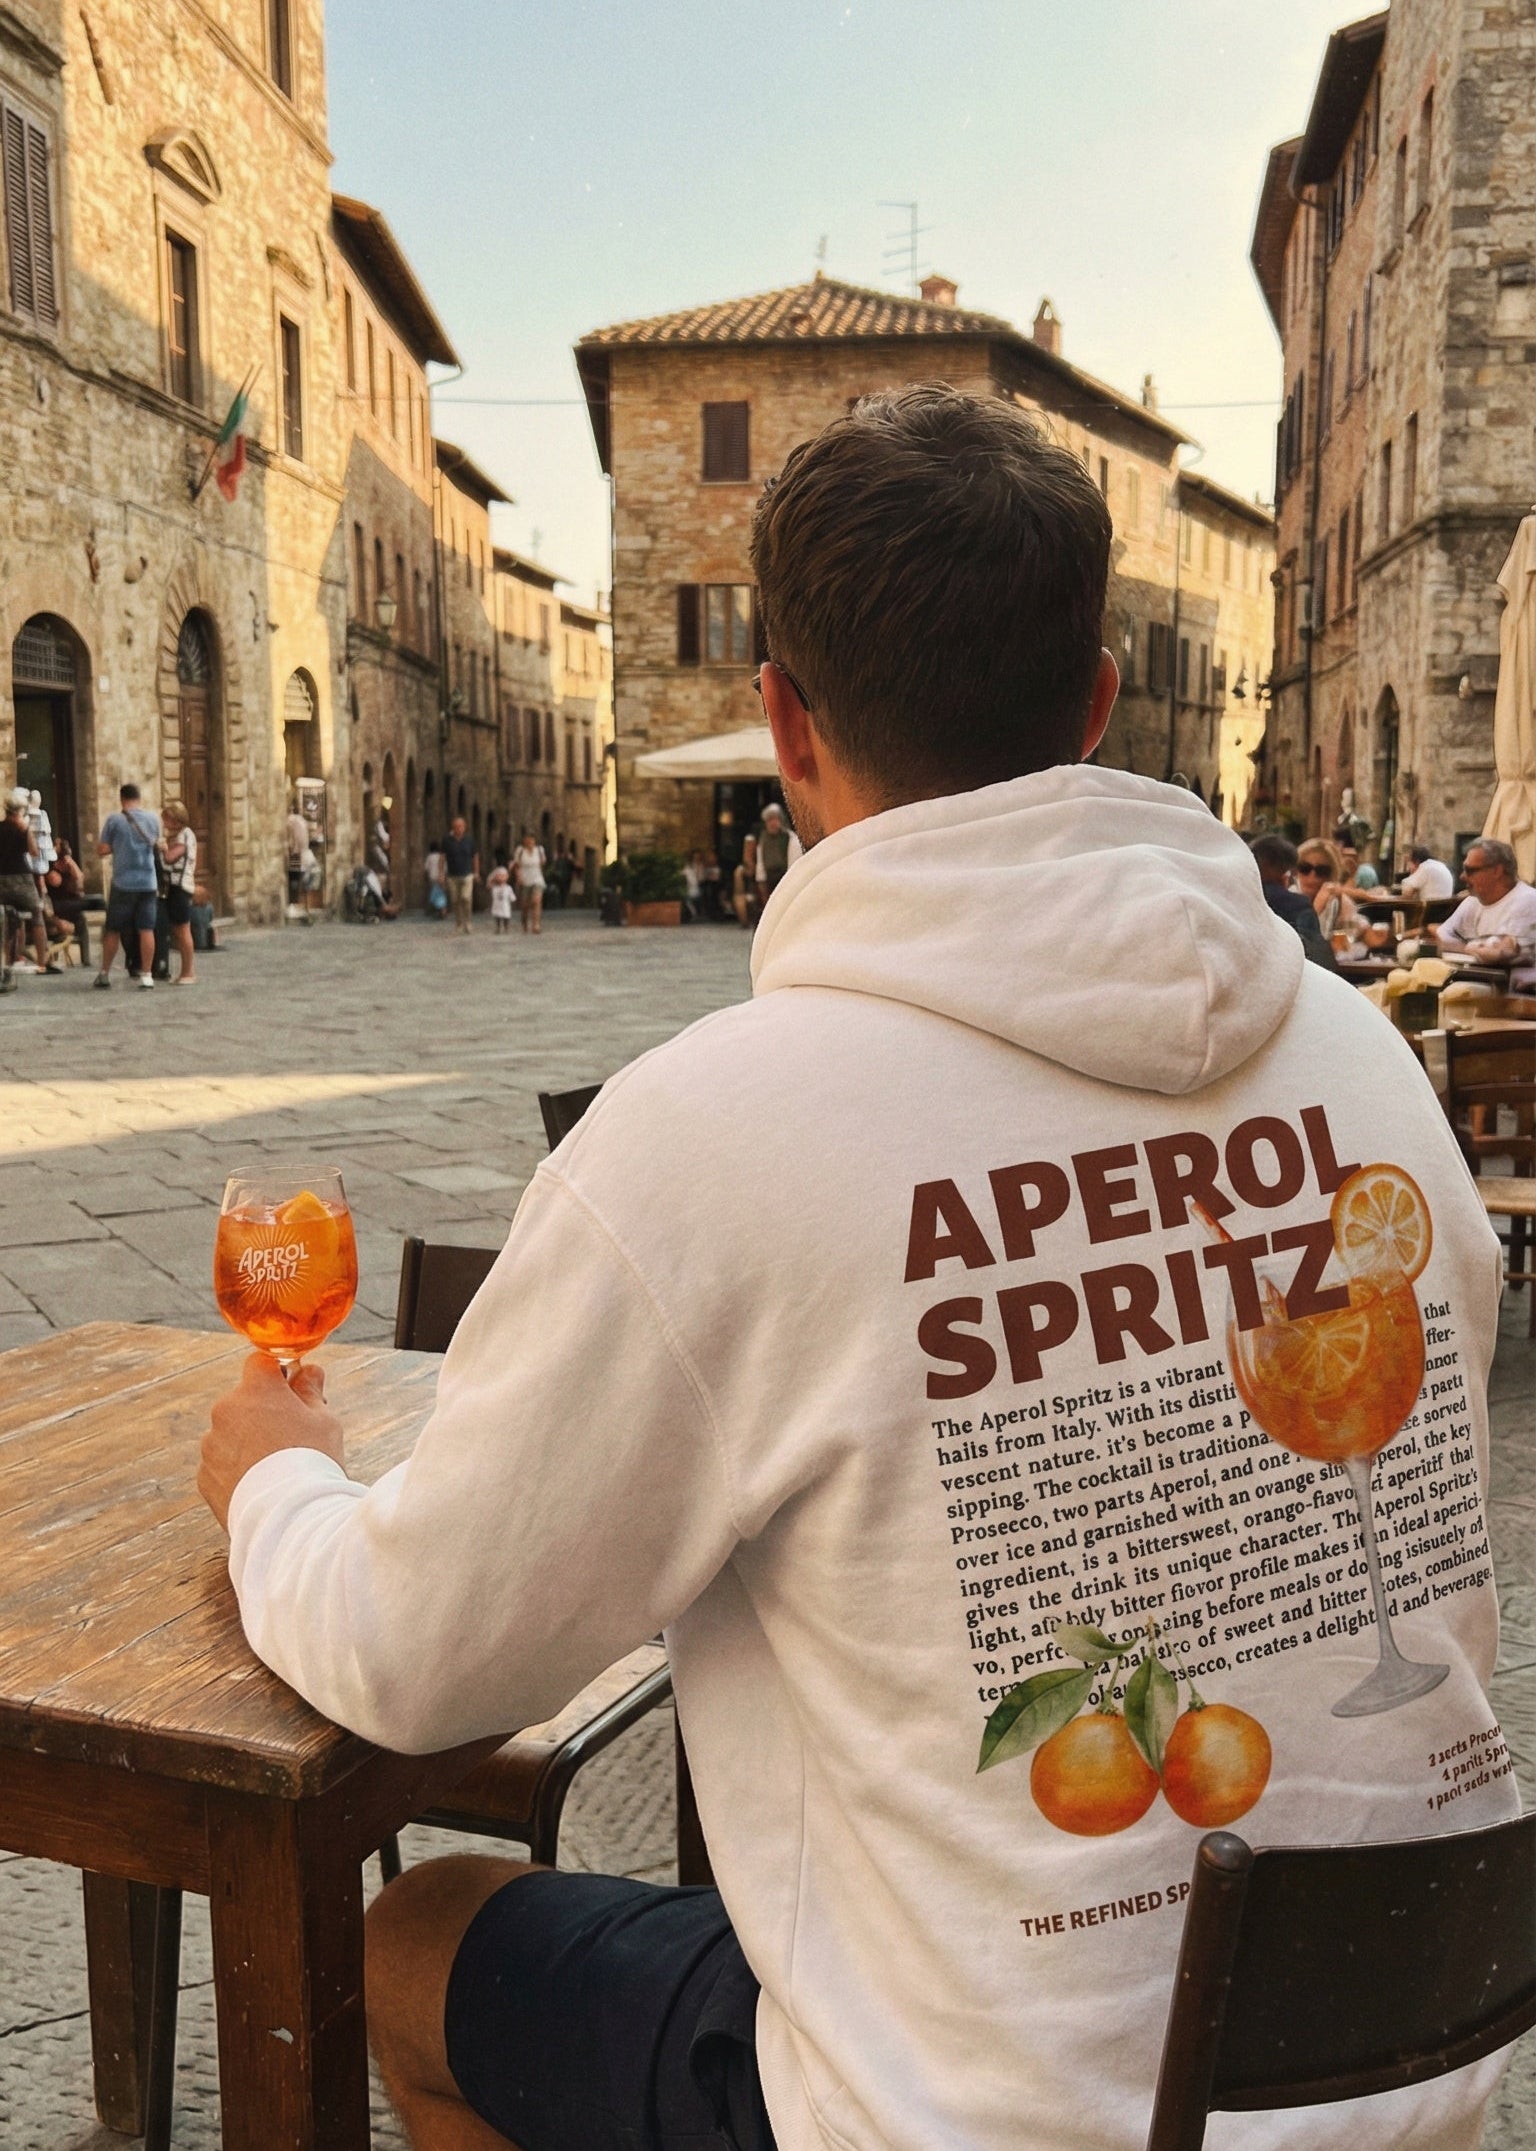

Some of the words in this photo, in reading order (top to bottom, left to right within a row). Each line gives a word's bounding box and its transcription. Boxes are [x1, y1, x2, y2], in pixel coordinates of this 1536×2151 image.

[904, 1105, 1362, 1283] APEROL
[238, 1242, 309, 1272] APEROL
[917, 1219, 1350, 1399] SPRITZ
[932, 1419, 972, 1439] The
[980, 1399, 1047, 1432] Aperol
[1052, 1388, 1113, 1417] Spritz
[1118, 1381, 1135, 1399] is
[1140, 1380, 1151, 1394] a
[1156, 1360, 1225, 1389] vibrant
[995, 1432, 1046, 1454] from
[1052, 1418, 1101, 1441] Italy.
[1106, 1403, 1154, 1428] With
[1159, 1399, 1183, 1417] its
[941, 1462, 1021, 1492] vescent
[1028, 1448, 1101, 1474] nature.
[1107, 1435, 1137, 1456] it's
[1143, 1418, 1215, 1447] become
[1222, 1414, 1233, 1428] a
[947, 1491, 1029, 1521] sipping.
[1034, 1479, 1072, 1500] The
[1078, 1456, 1153, 1490] cocktail
[1158, 1454, 1175, 1471] is
[956, 1551, 999, 1570] over
[1006, 1543, 1035, 1561] ice
[1041, 1528, 1077, 1553] and
[1083, 1504, 1178, 1548] garnished
[1182, 1493, 1224, 1518] with
[1228, 1490, 1250, 1506] an
[1424, 1430, 1447, 1449] the
[1451, 1423, 1472, 1441] key
[1053, 1504, 1089, 1523] two
[1095, 1490, 1145, 1518] parts
[1220, 1457, 1254, 1482] and
[1258, 1452, 1291, 1471] one
[960, 1560, 1075, 1598] ingredient,
[1082, 1553, 1099, 1571] is
[1107, 1551, 1118, 1565] a
[966, 1602, 1020, 1628] gives
[1029, 1590, 1062, 1610] the
[1071, 1572, 1127, 1600] drink
[1134, 1567, 1160, 1585] its
[1167, 1548, 1232, 1576] unique
[1239, 1522, 1328, 1556] character.
[1374, 1486, 1426, 1519] Aperol
[969, 1626, 1026, 1652] light,
[1110, 1592, 1166, 1617] bitter
[1229, 1556, 1289, 1591] profile
[1294, 1542, 1349, 1568] makes
[1393, 1509, 1430, 1537] ideal
[1198, 1626, 1217, 1648] of
[1224, 1613, 1275, 1641] sweet
[1281, 1598, 1314, 1624] and
[1382, 1571, 1422, 1593] otes,
[1425, 1538, 1490, 1577] combined
[973, 1660, 1005, 1675] vo,
[1206, 1592, 1265, 1619] before
[1270, 1573, 1321, 1601] meals
[1325, 1568, 1344, 1584] or
[1235, 1635, 1298, 1665] creates
[1302, 1630, 1313, 1644] a
[1403, 1587, 1430, 1613] and
[1432, 1567, 1493, 1600] beverage.
[1020, 1914, 1066, 1937] THE
[1070, 1891, 1162, 1929] REFINED
